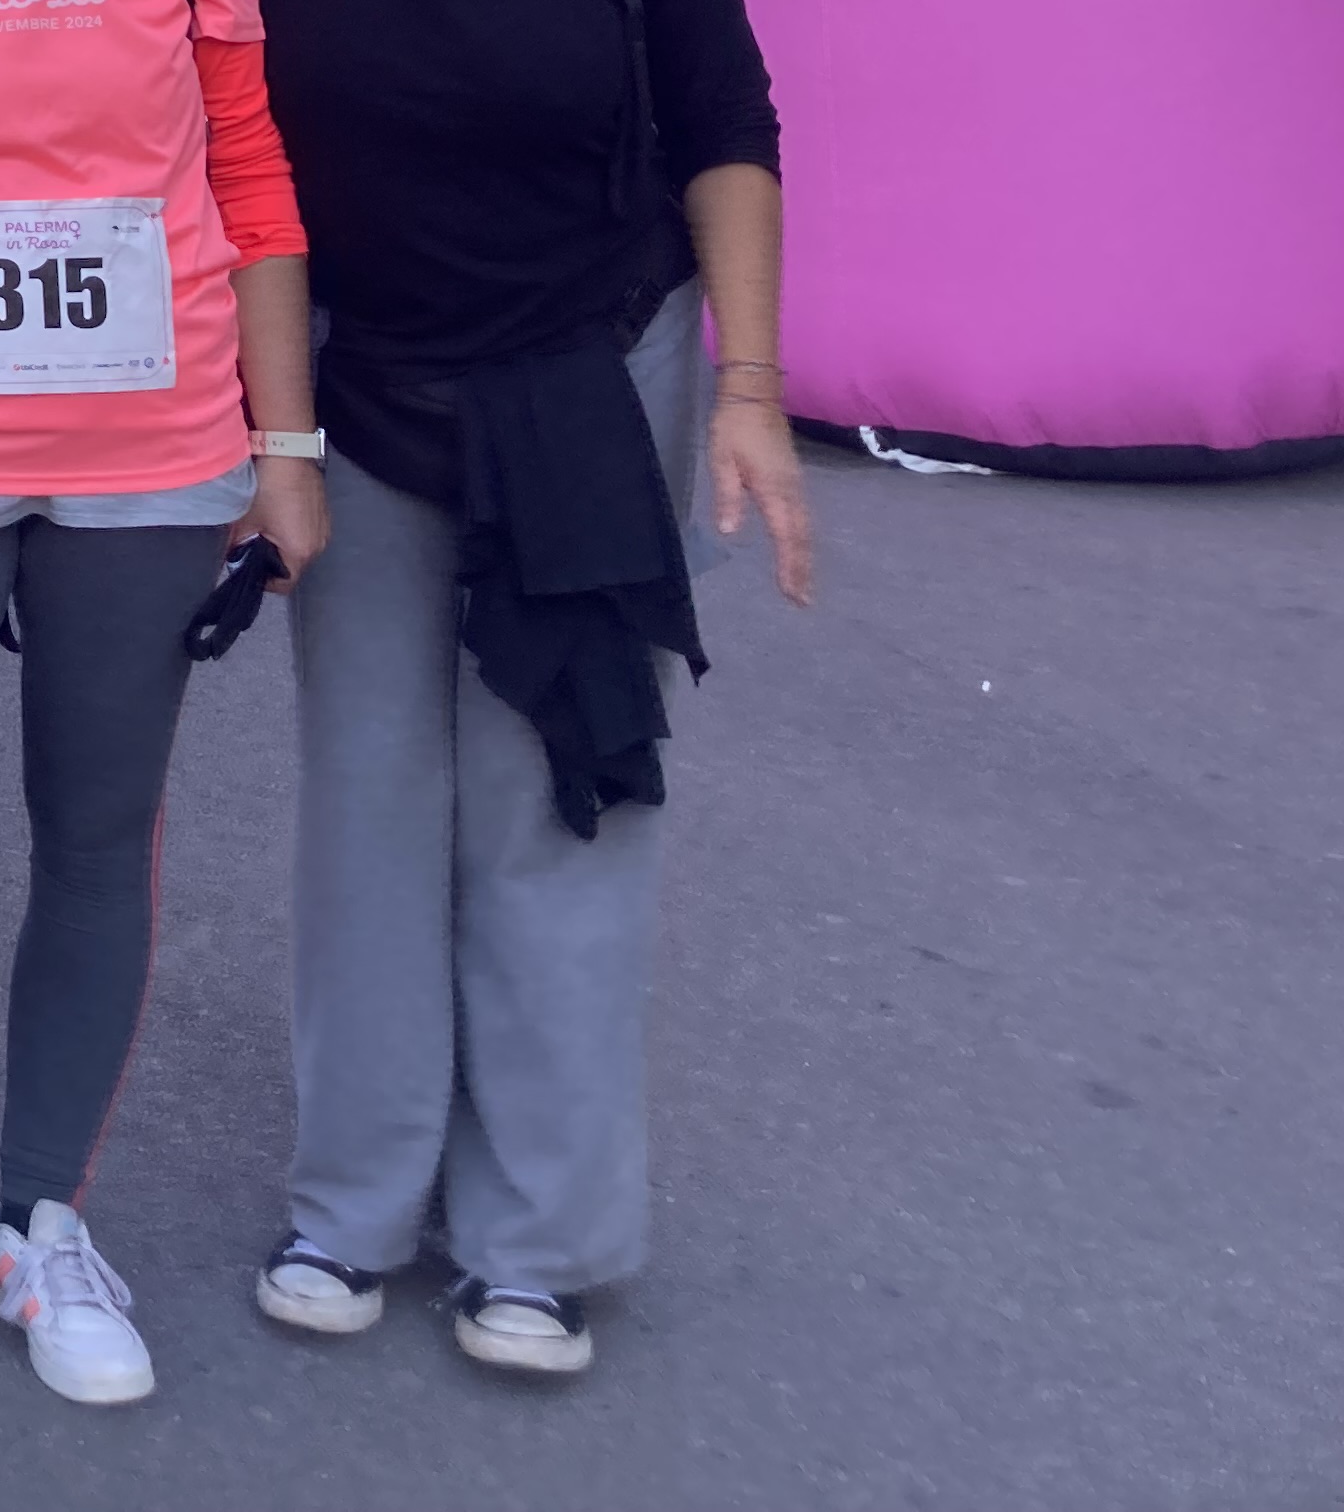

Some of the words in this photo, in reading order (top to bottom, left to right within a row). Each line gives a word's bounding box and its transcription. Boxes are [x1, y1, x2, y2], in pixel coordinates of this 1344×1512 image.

[64, 15, 103, 29] 2024
[4, 220, 81, 236] PALERMO
[6, 238, 23, 250] in
[27, 237, 71, 249] Rosa
